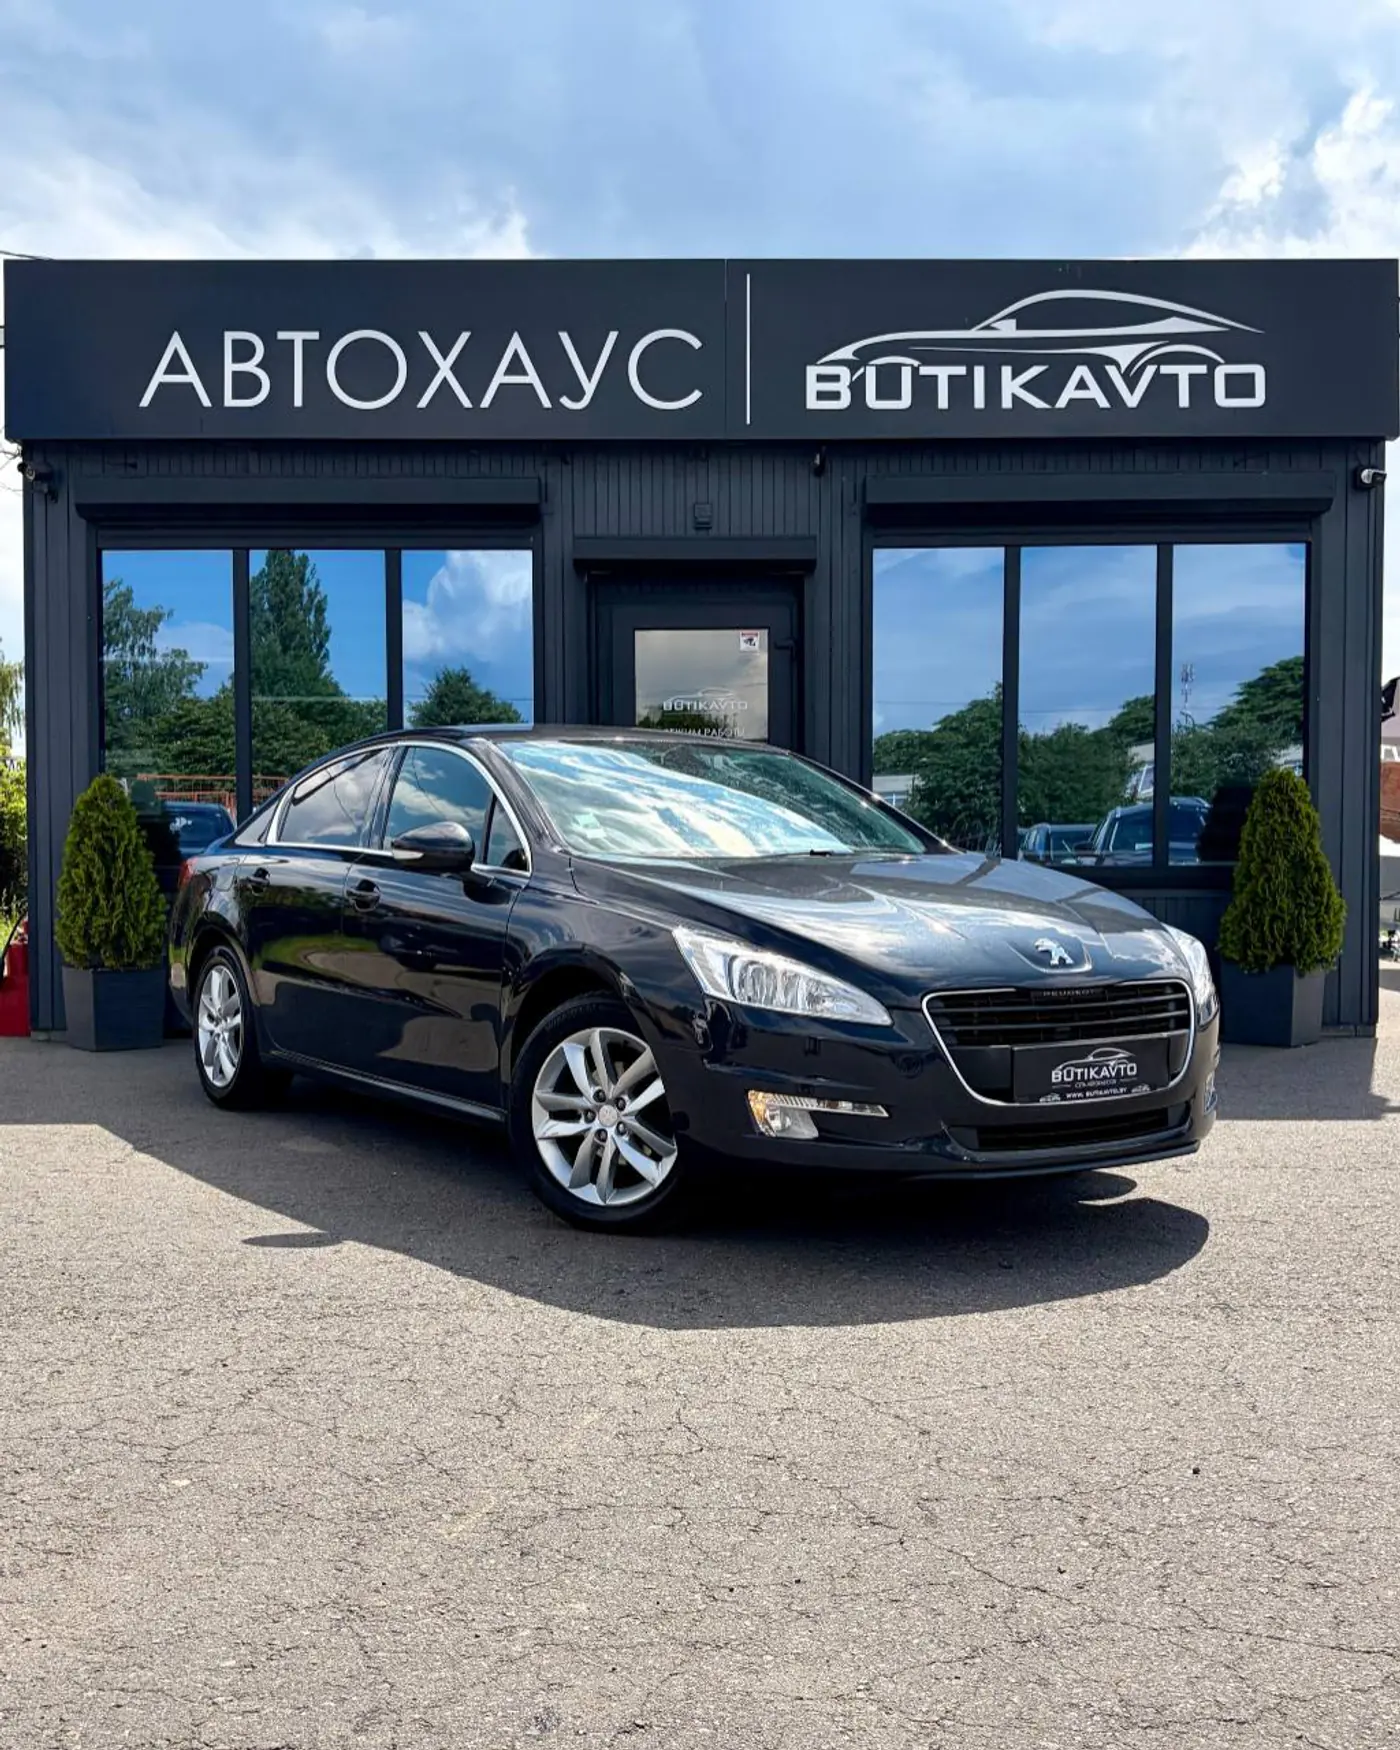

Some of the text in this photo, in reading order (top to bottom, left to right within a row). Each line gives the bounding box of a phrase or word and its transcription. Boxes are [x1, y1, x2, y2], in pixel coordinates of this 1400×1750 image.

[139, 328, 704, 411] АВТОХАУС
[805, 363, 1266, 410] BUTIKAVTO
[1051, 1062, 1138, 1083] BUTIKAVTO
